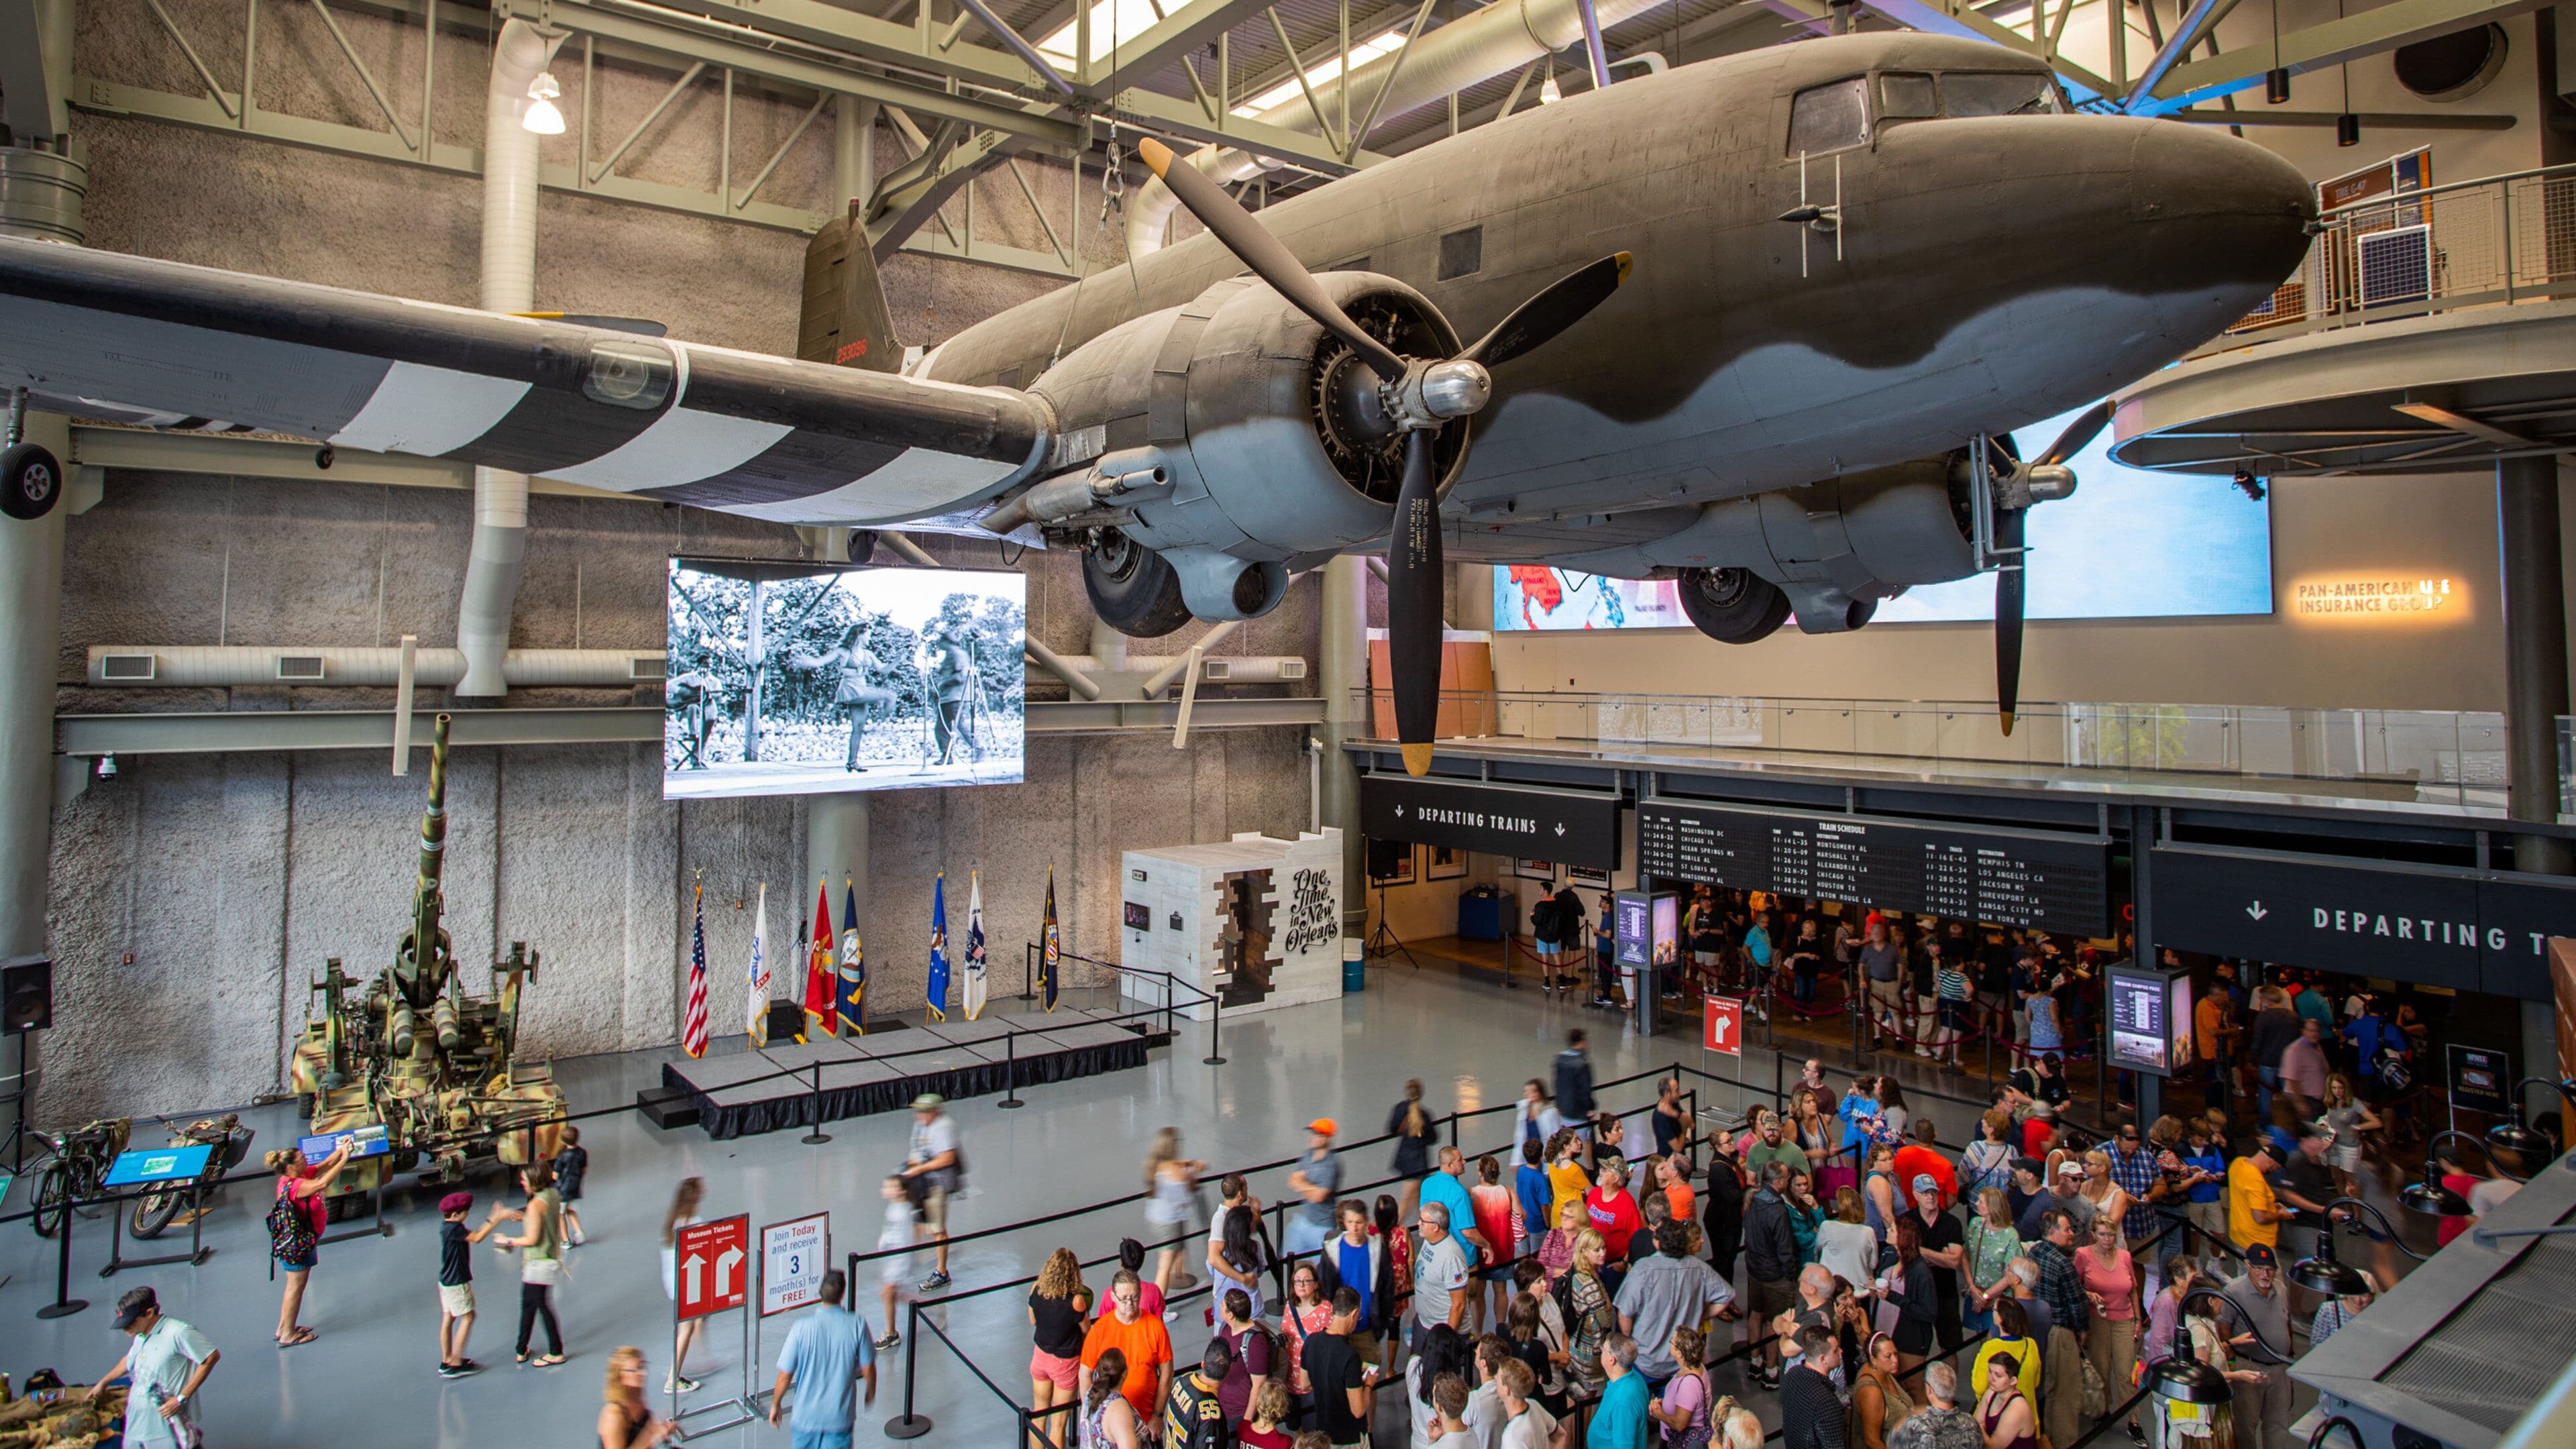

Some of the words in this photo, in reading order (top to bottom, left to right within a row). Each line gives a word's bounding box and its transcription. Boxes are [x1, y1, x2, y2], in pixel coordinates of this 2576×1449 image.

[2300, 581, 2413, 598] PAN-AMERICAN
[2300, 598, 2381, 613] INSURANCE
[2388, 596, 2443, 612] GROUP
[1419, 807, 1485, 827] DEPARTING
[1491, 815, 1536, 834] TRAINS
[1681, 827, 1714, 836] WASHINGTON
[1819, 822, 1837, 831] TRAIN
[1837, 824, 1865, 835] SCHEDULE
[1681, 836, 1704, 844] CHICAGO
[1817, 841, 1856, 851] MONTGOMERY
[1701, 848, 1724, 856] SPRINGS
[1817, 851, 1847, 860] MARSHALL
[1817, 861, 1856, 871] ALEXANDRIA
[1949, 855, 1967, 863] E-43
[1978, 859, 2010, 867] MEMPHIS
[1681, 873, 1713, 883] MONTGOMERY
[1817, 871, 1844, 880] CHICAGO
[1927, 874, 1947, 882] 11:28
[1979, 880, 2010, 890] JACKSON
[1996, 871, 2029, 880] ANGELES
[1817, 881, 1844, 890] HOUSTON
[1774, 885, 1791, 894] 11:44
[1817, 891, 1836, 899] BATON
[1839, 895, 1860, 903] ROUGE
[1927, 885, 1947, 893] 11:34
[1979, 891, 2024, 902] SHREVEPORT
[1299, 899, 1335, 930] New
[1979, 902, 2006, 911] KANSAS
[2011, 906, 2029, 914] CITY
[1997, 915, 2015, 924] YORK
[2314, 907, 2507, 951] DEPARTING
[1286, 922, 1338, 953] Orleans
[2458, 1086, 2484, 1095] REGISTER
[687, 1229, 712, 1240] Museum
[713, 1224, 734, 1234] Tickets
[773, 1230, 789, 1242] Join
[792, 1224, 816, 1239] Today
[772, 1242, 788, 1254] and
[790, 1236, 818, 1250] receive
[790, 1255, 800, 1275] 3
[770, 1277, 806, 1296] month(s)
[808, 1275, 820, 1286] for
[782, 1289, 806, 1304] FREE!
[1171, 1381, 1193, 1414] FUJITA
[1198, 1399, 1221, 1420] 55
